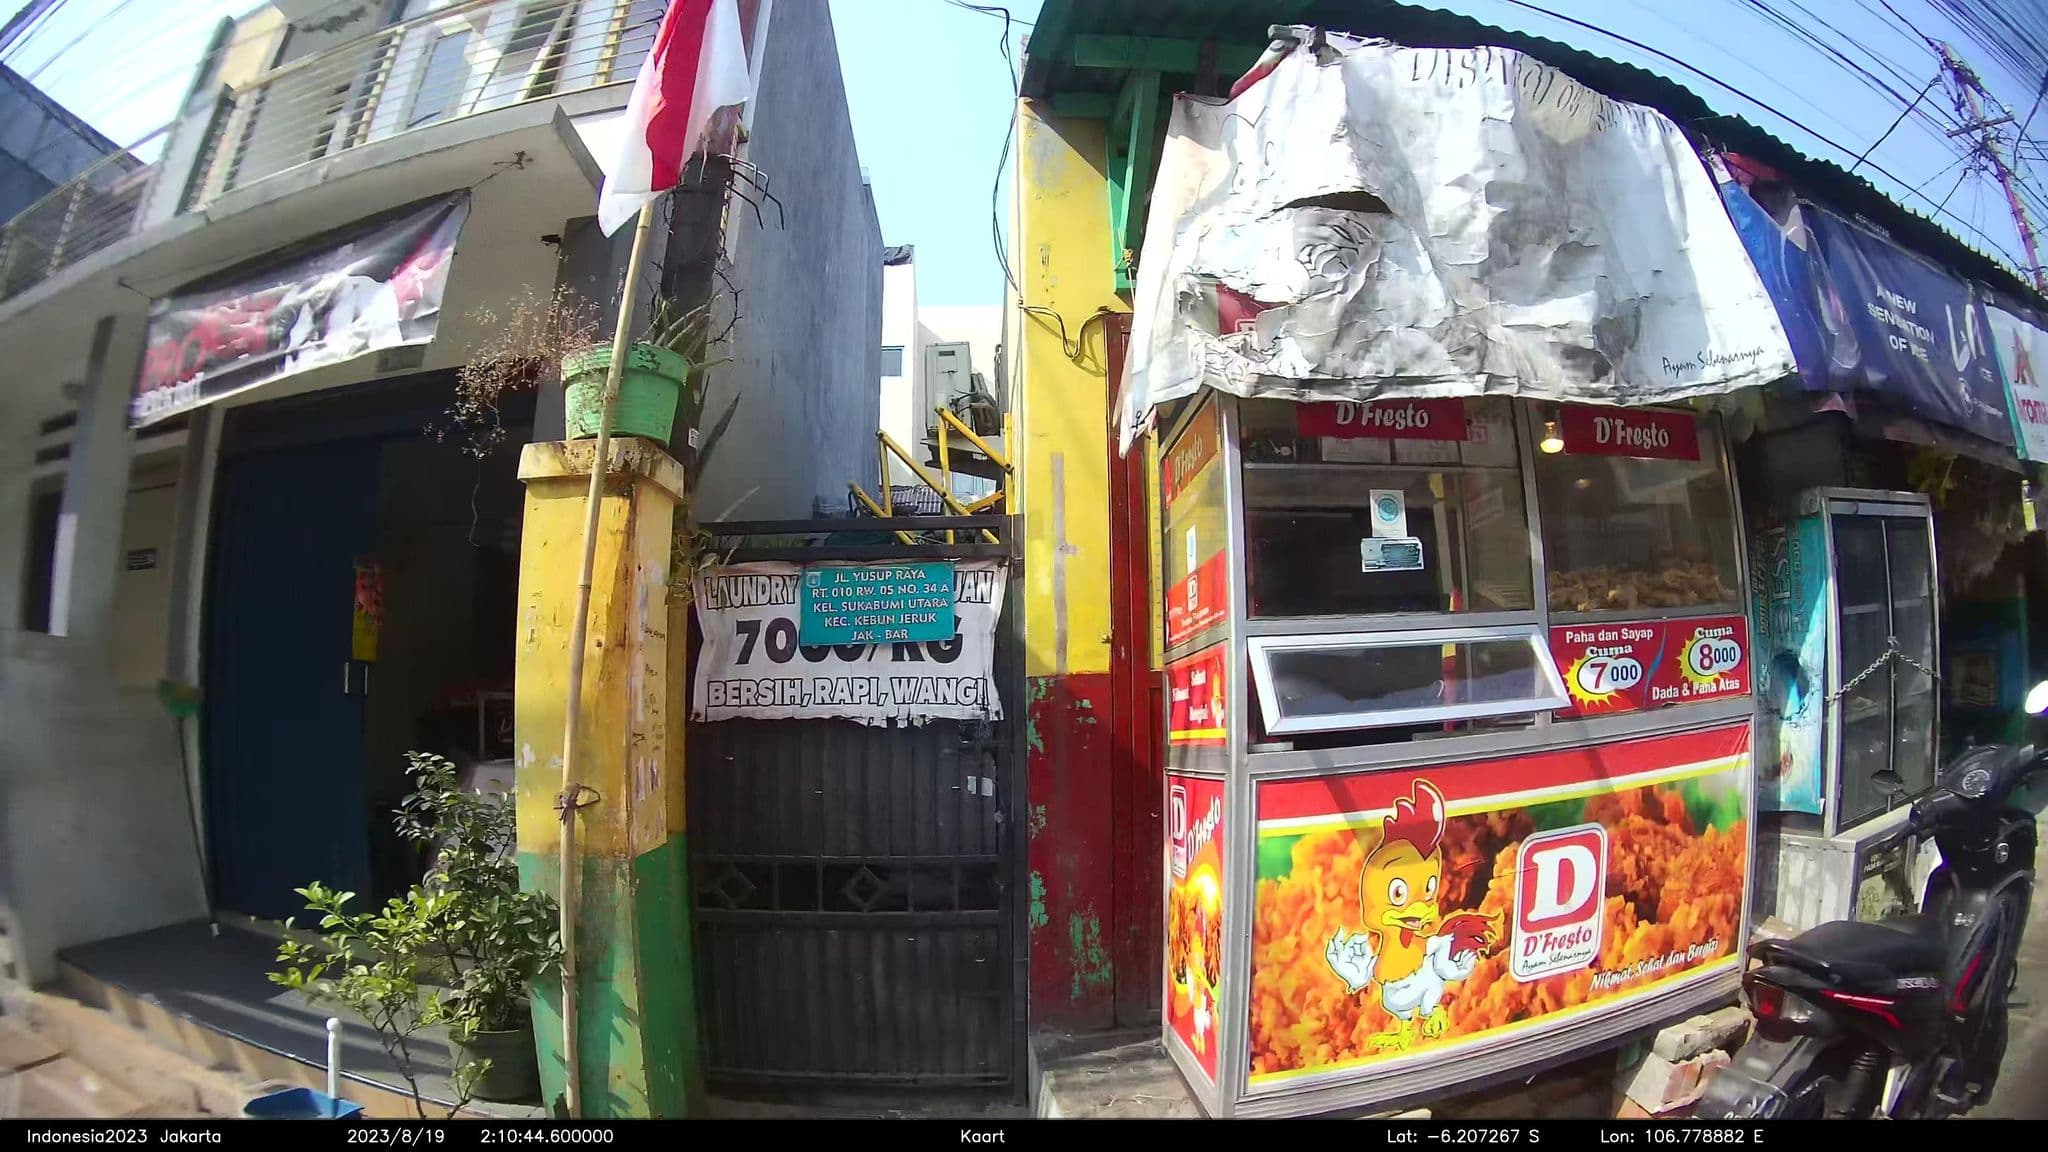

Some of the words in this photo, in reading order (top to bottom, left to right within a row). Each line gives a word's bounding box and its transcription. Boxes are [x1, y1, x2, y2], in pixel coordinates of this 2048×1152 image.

[1886, 291, 1916, 315] NEW
[1889, 335, 1908, 352] OF
[1662, 356, 1697, 379] Ayam
[1336, 401, 1429, 430] D'Fresto
[1593, 416, 1669, 449] D'Fresto
[834, 572, 849, 584] JL.
[852, 570, 892, 582] YUSUP
[895, 569, 926, 580] RAYA
[704, 573, 799, 610] LAUNDRY
[812, 587, 829, 599] RT.
[831, 587, 853, 598] 010
[856, 586, 876, 597] RW.
[880, 585, 894, 596] 05
[898, 584, 919, 595] NO.
[923, 583, 938, 594] 34
[940, 583, 950, 593] A
[813, 602, 838, 614] KEL.
[841, 599, 904, 613] SUKABUMI
[908, 598, 949, 609] UTARA
[824, 616, 851, 628] KEC.
[854, 614, 895, 627] KEBUN
[899, 612, 938, 625] JERUK
[851, 630, 874, 642] JAK
[885, 628, 909, 640] BAR
[1566, 631, 1595, 644] Paha
[1598, 630, 1619, 641] dan
[1621, 627, 1653, 643] Sayap
[707, 677, 812, 708] BERSIH,
[812, 676, 888, 707] RAPI,
[1652, 684, 1679, 701] Dada
[1682, 683, 1690, 697] &
[1720, 678, 1740, 691] Atas
[1173, 796, 1186, 841] D
[1527, 845, 1597, 922] D
[1522, 926, 1592, 957] D'Fresto
[1665, 950, 1686, 967] dan
